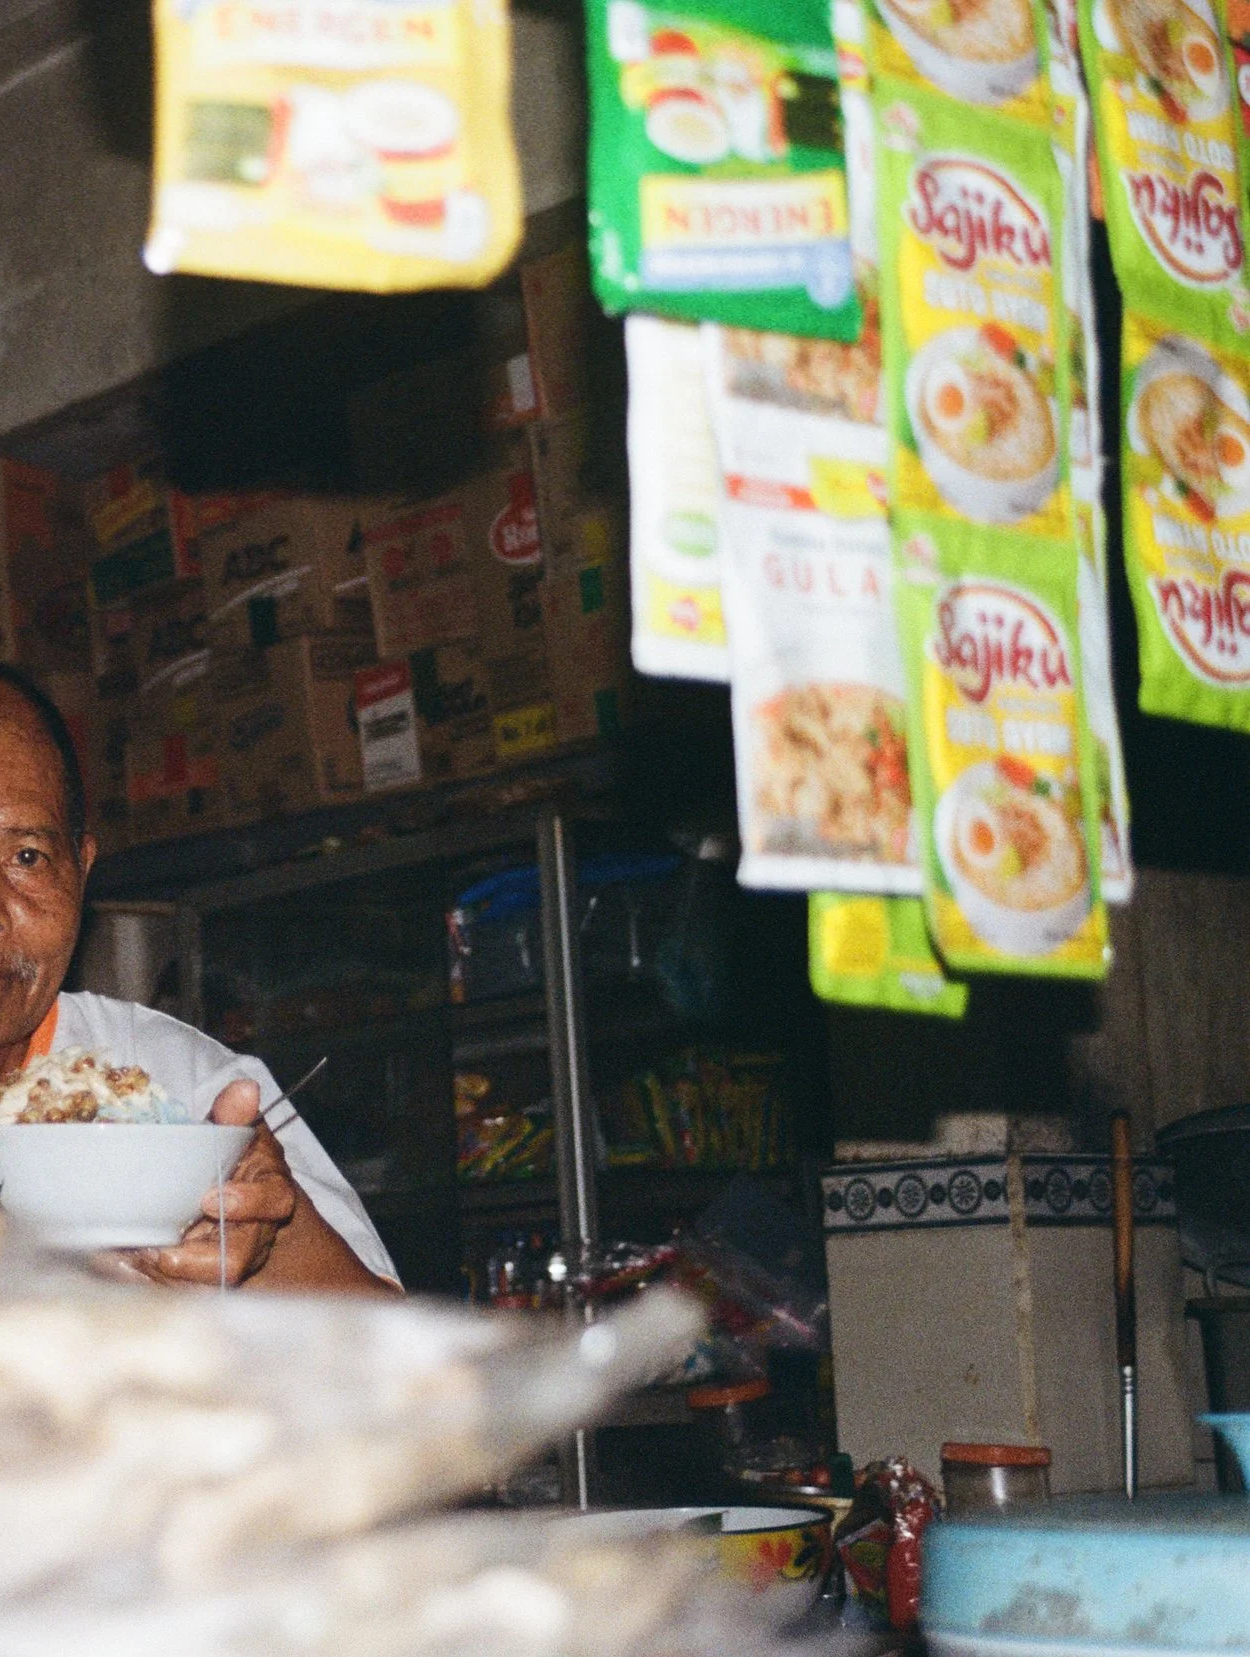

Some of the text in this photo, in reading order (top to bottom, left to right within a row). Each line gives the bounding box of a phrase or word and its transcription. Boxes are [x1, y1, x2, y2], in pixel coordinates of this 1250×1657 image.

[908, 170, 1051, 271] Sajiku
[1128, 171, 1243, 271] Sajiku
[761, 552, 881, 601] GULA
[1154, 570, 1250, 658] ajiku
[933, 597, 1074, 703] Sajiku
